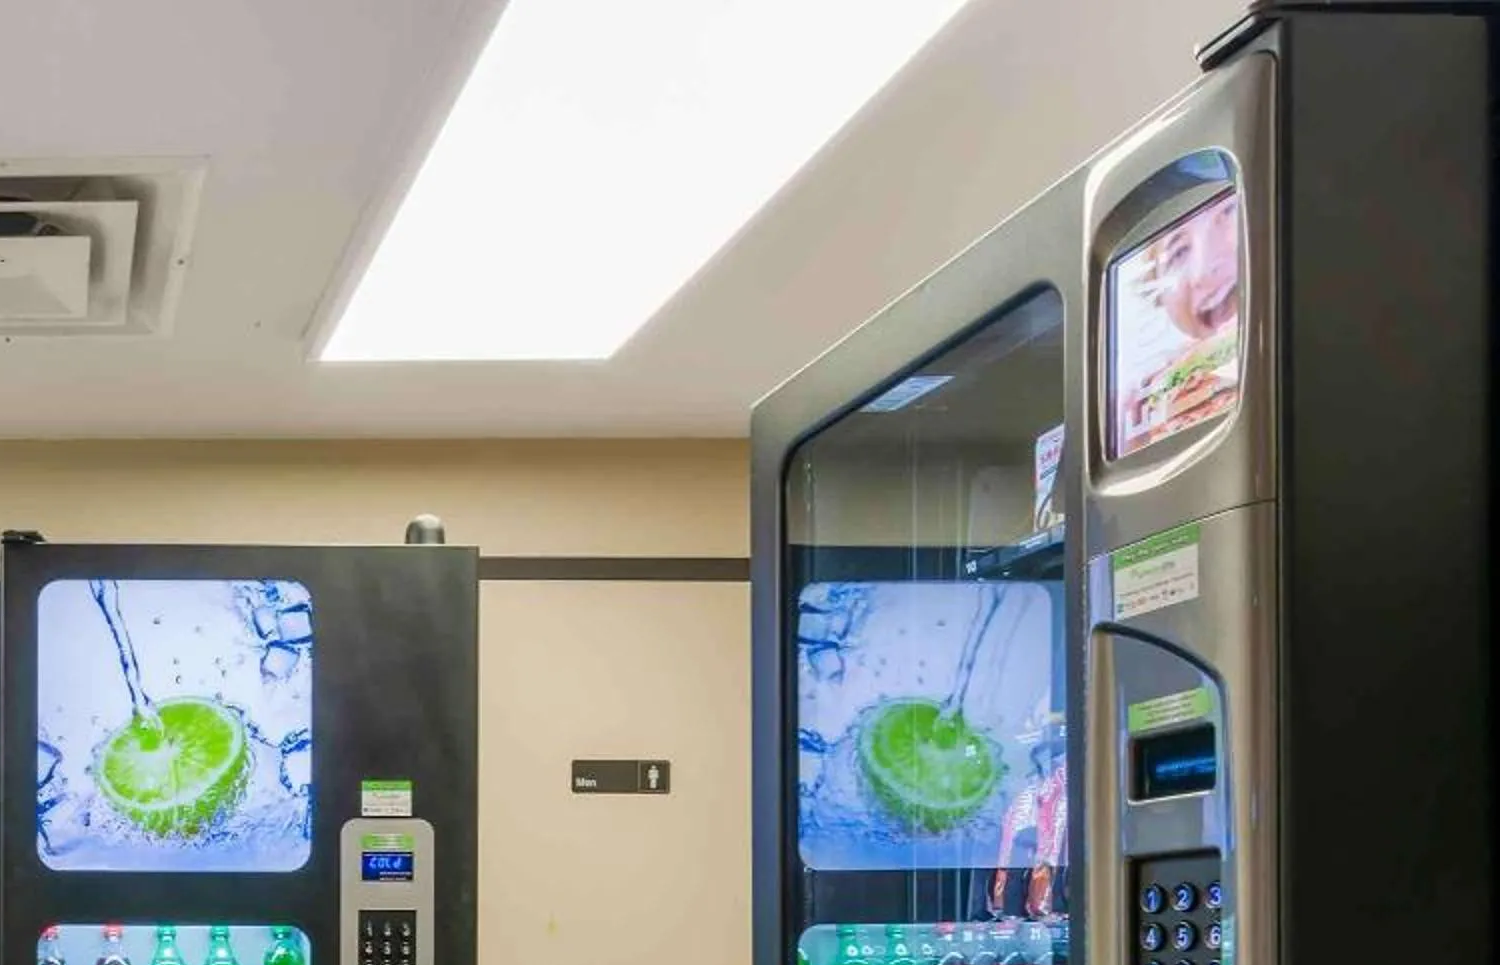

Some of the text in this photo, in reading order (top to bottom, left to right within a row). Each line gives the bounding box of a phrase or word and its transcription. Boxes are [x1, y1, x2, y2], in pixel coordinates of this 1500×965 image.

[575, 777, 597, 787] Men
[1147, 887, 1221, 906] 1 2 3
[1145, 927, 1221, 945] 4 5 6
